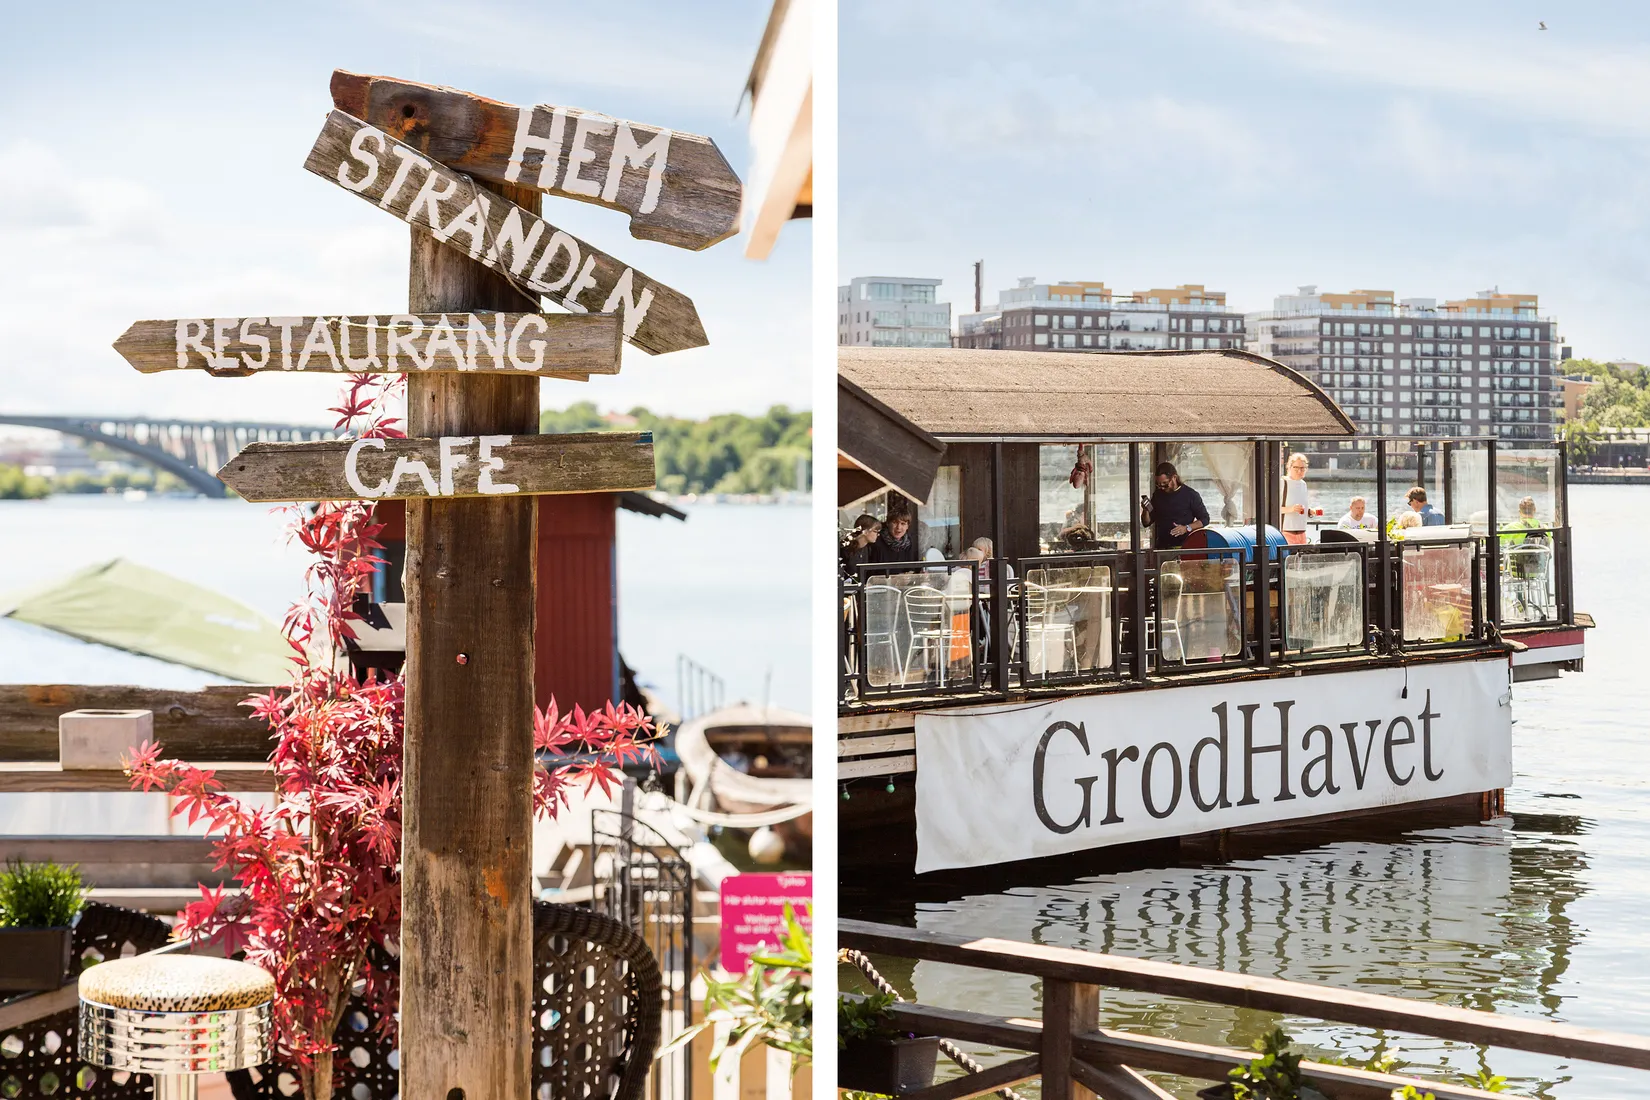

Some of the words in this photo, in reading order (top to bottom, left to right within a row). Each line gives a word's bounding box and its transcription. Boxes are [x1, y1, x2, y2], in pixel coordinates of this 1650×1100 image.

[505, 106, 672, 214] HEM
[337, 127, 655, 342] STRANDEN
[175, 313, 549, 372] RESTAURANG
[345, 435, 520, 498] CAFE
[1033, 688, 1444, 834] GrodHavet
